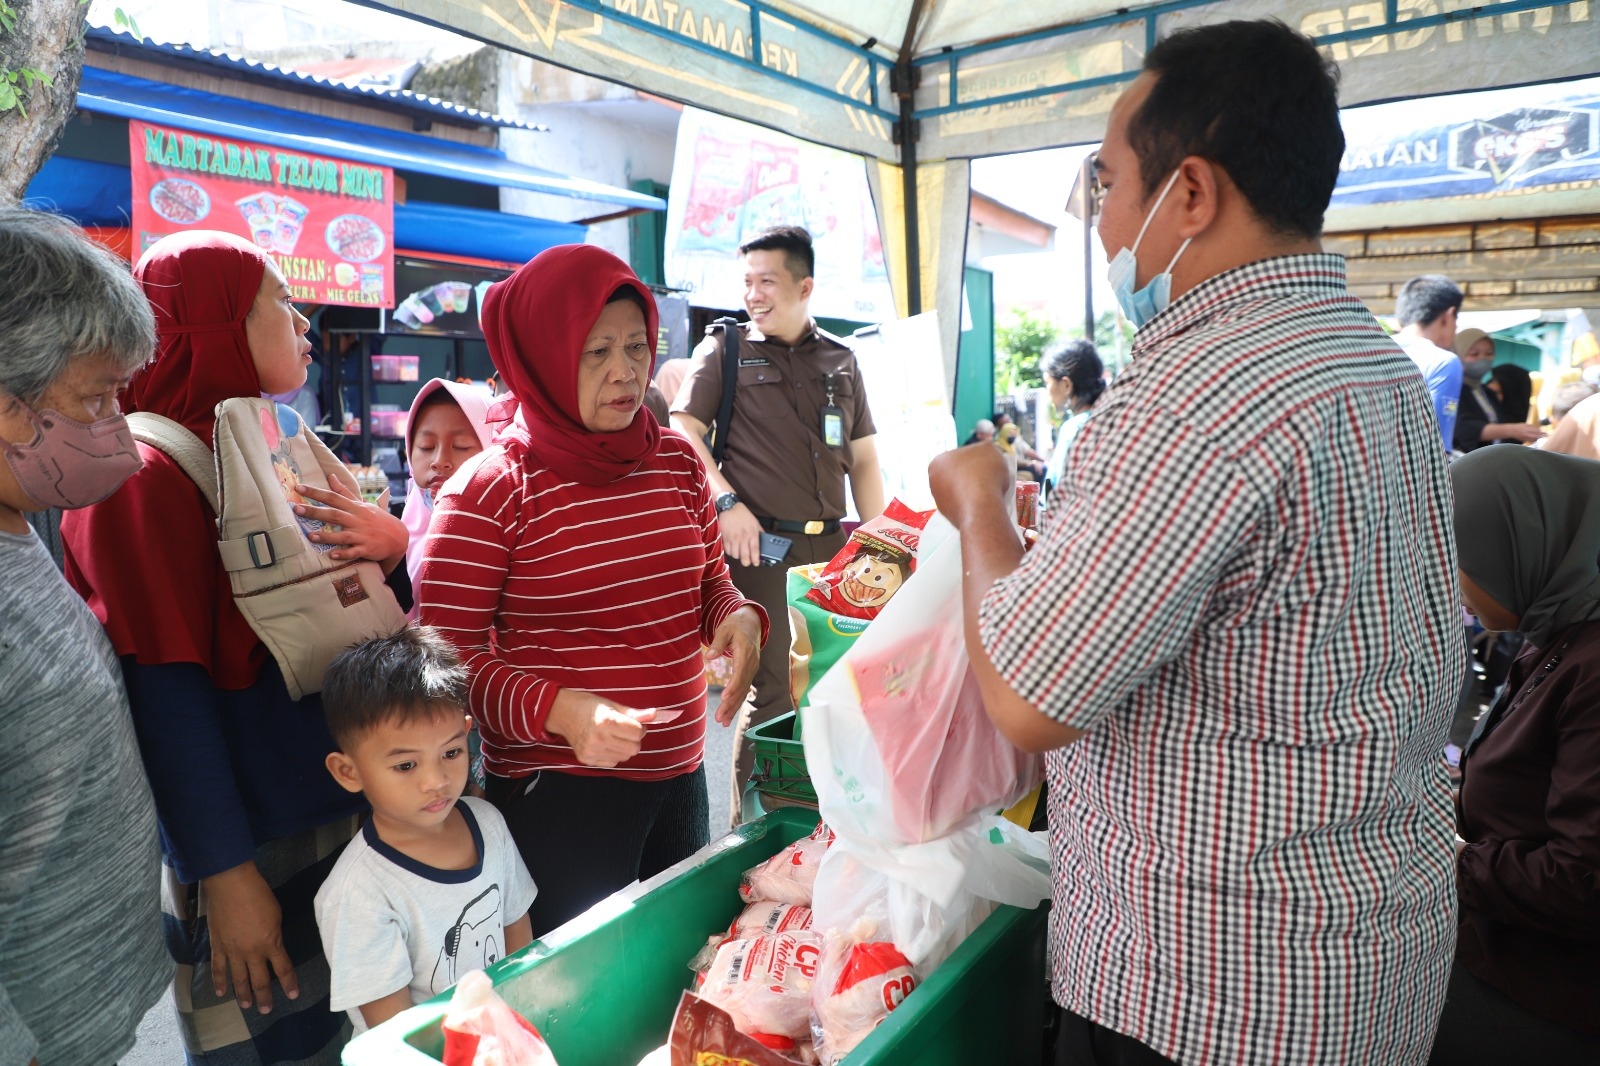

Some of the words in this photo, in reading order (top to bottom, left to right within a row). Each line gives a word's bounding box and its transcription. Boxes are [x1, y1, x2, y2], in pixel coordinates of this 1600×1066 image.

[144, 128, 272, 182] MARTABAK
[275, 153, 339, 193] TELOR
[341, 163, 383, 200] MINI
[326, 288, 345, 302] MIE
[347, 289, 381, 304] GELAS
[772, 933, 797, 982] Chicken
[793, 944, 820, 978] CP
[882, 974, 915, 1012] CP
